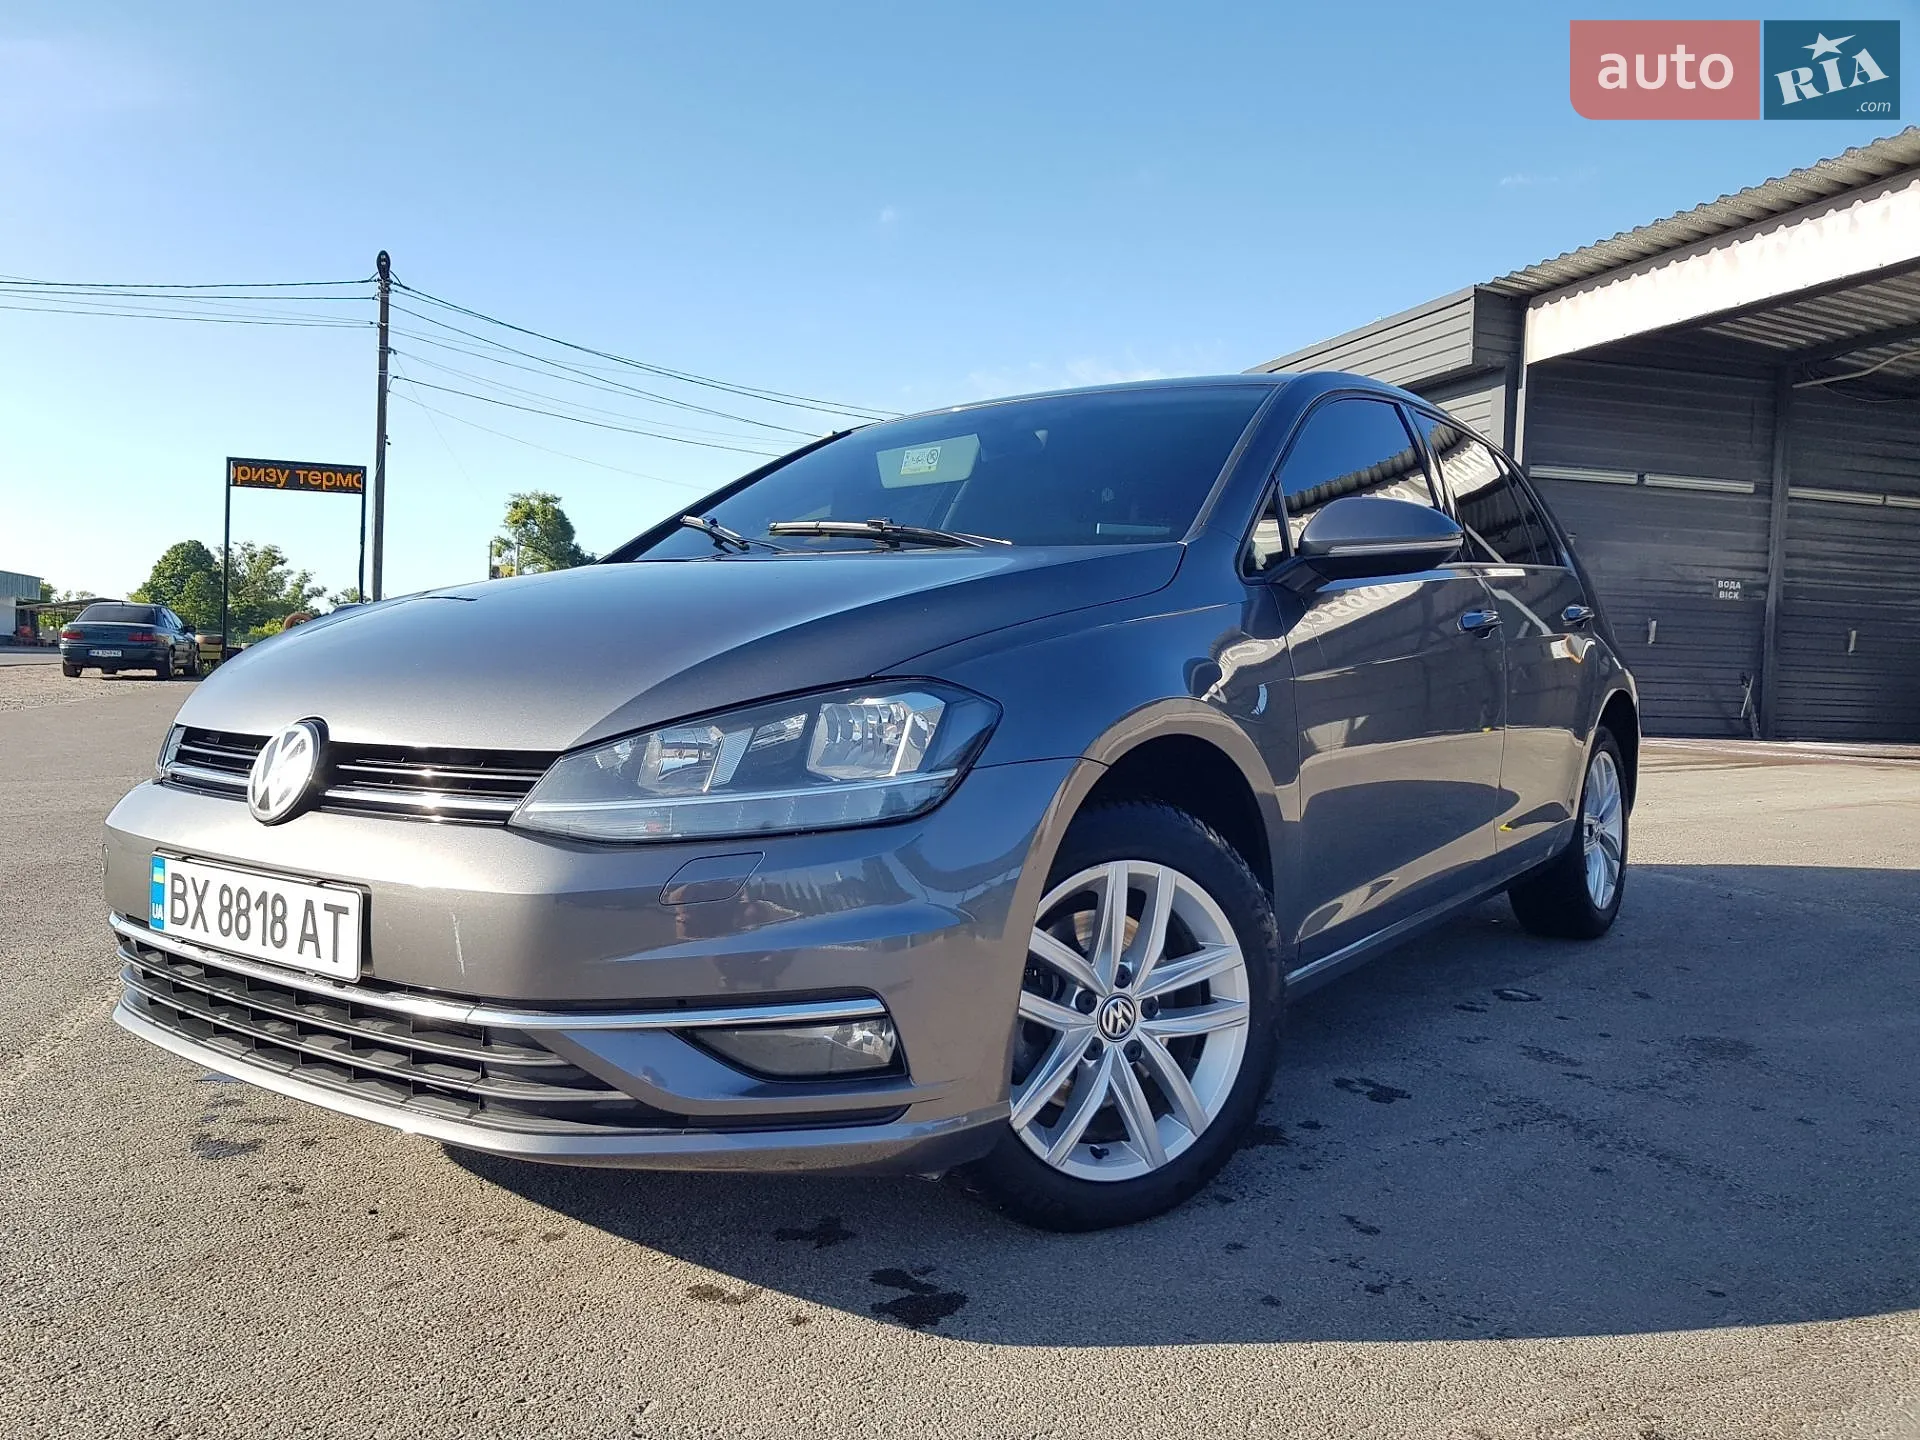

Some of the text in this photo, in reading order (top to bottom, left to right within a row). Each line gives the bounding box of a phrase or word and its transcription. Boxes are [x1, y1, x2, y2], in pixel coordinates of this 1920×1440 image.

[1717, 580, 1741, 590] ВОДА
[151, 902, 164, 921] UA
[170, 872, 350, 963] BX 8818 AT
